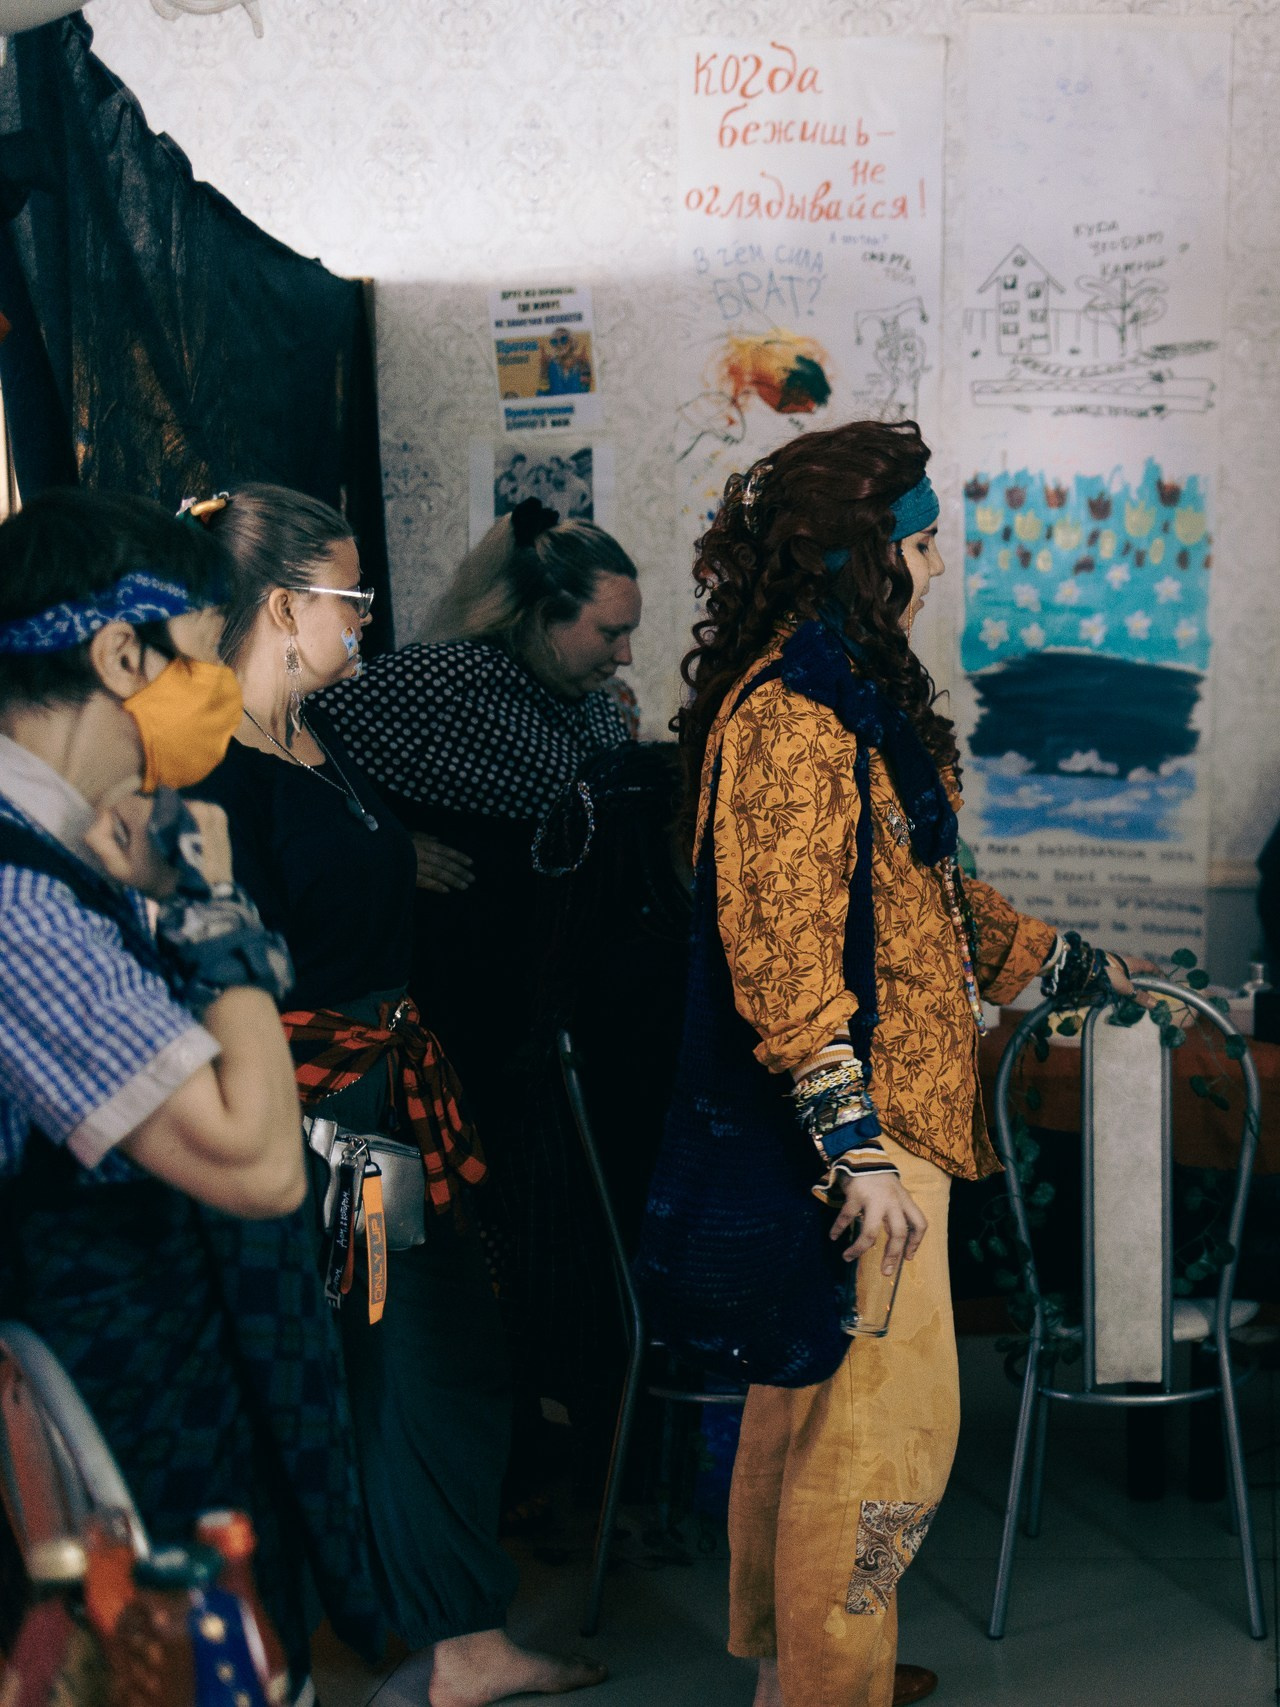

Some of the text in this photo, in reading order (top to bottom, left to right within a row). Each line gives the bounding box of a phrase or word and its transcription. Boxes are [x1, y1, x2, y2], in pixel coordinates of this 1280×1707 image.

[684, 171, 927, 223] оглядывайся!
[371, 1218, 384, 1301] ONLY UP
